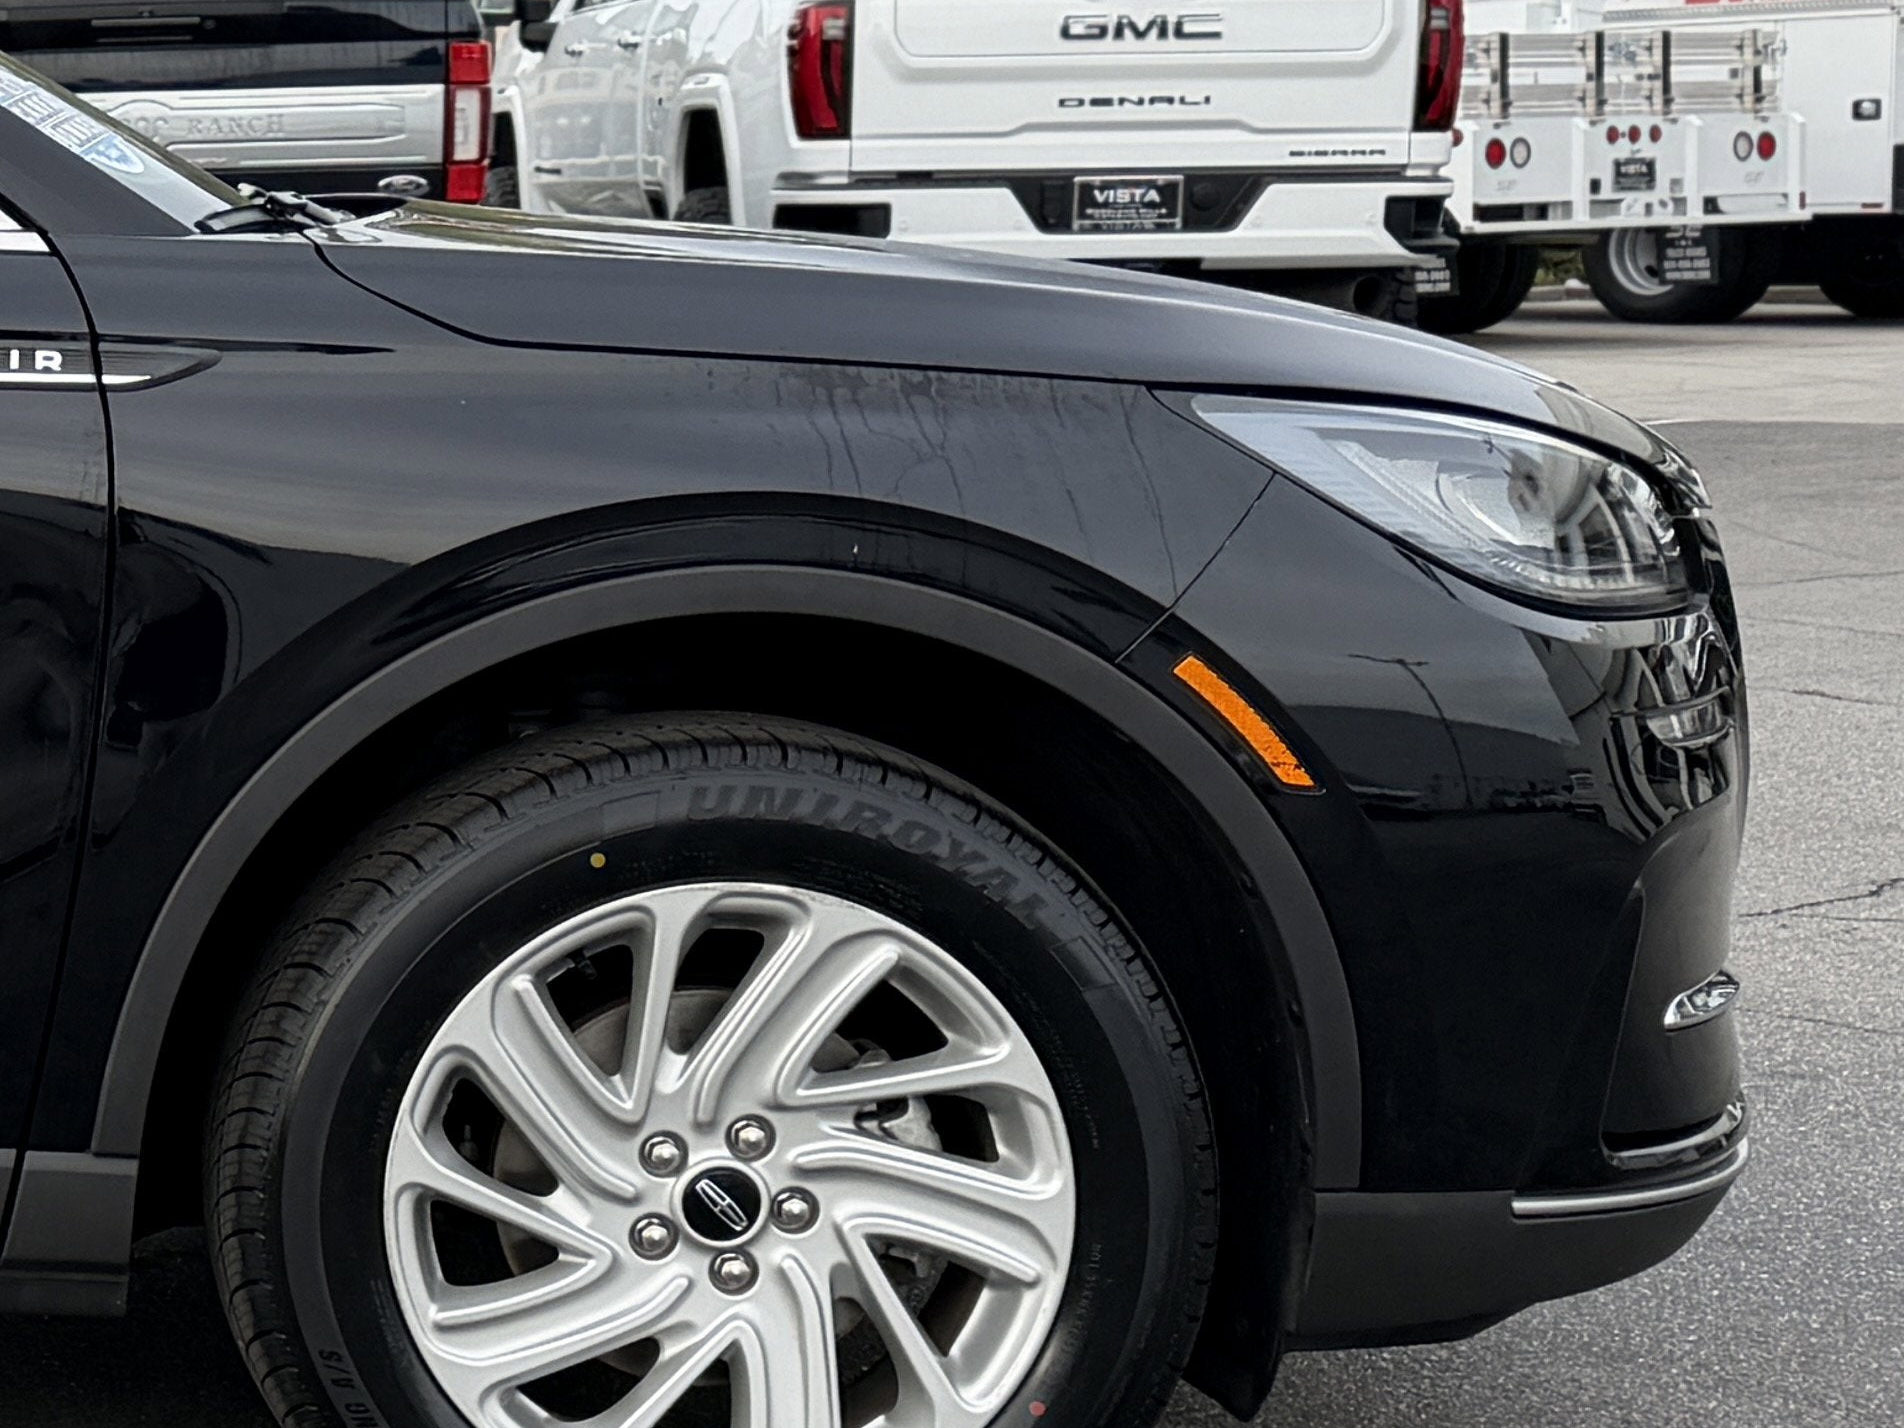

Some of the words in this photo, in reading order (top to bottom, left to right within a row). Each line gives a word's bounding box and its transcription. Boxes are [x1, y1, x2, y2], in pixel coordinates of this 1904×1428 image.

[1059, 13, 1223, 41] GMC
[1058, 95, 1211, 108] DENALI
[186, 113, 284, 137] RANCH
[1093, 188, 1161, 204] VISTA
[688, 784, 1050, 930] UNIROYAL
[318, 1346, 358, 1390] A/S
